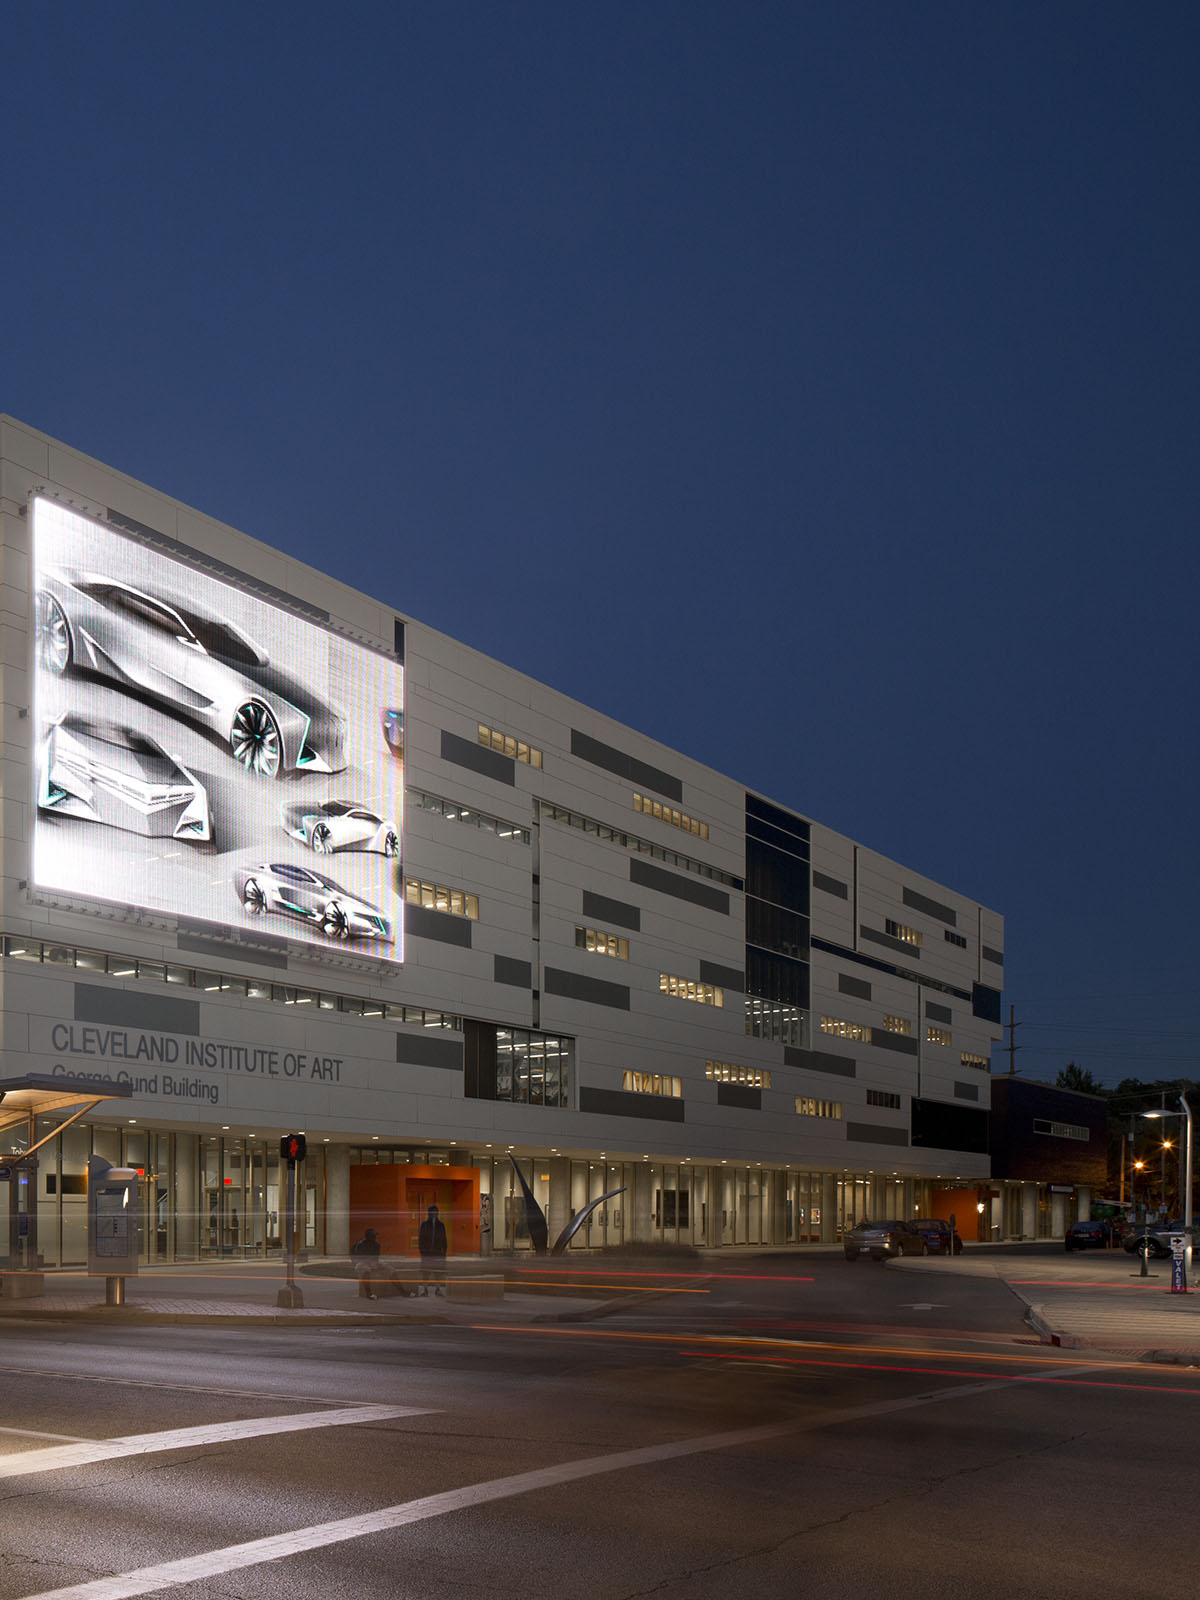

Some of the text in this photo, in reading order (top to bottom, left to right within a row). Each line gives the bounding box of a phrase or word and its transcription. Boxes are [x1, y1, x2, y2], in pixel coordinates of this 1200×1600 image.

[51, 1023, 344, 1082] CLEVELAND INSTITUTE OF ART
[116, 1070, 158, 1095] Gund
[162, 1075, 219, 1105] Building
